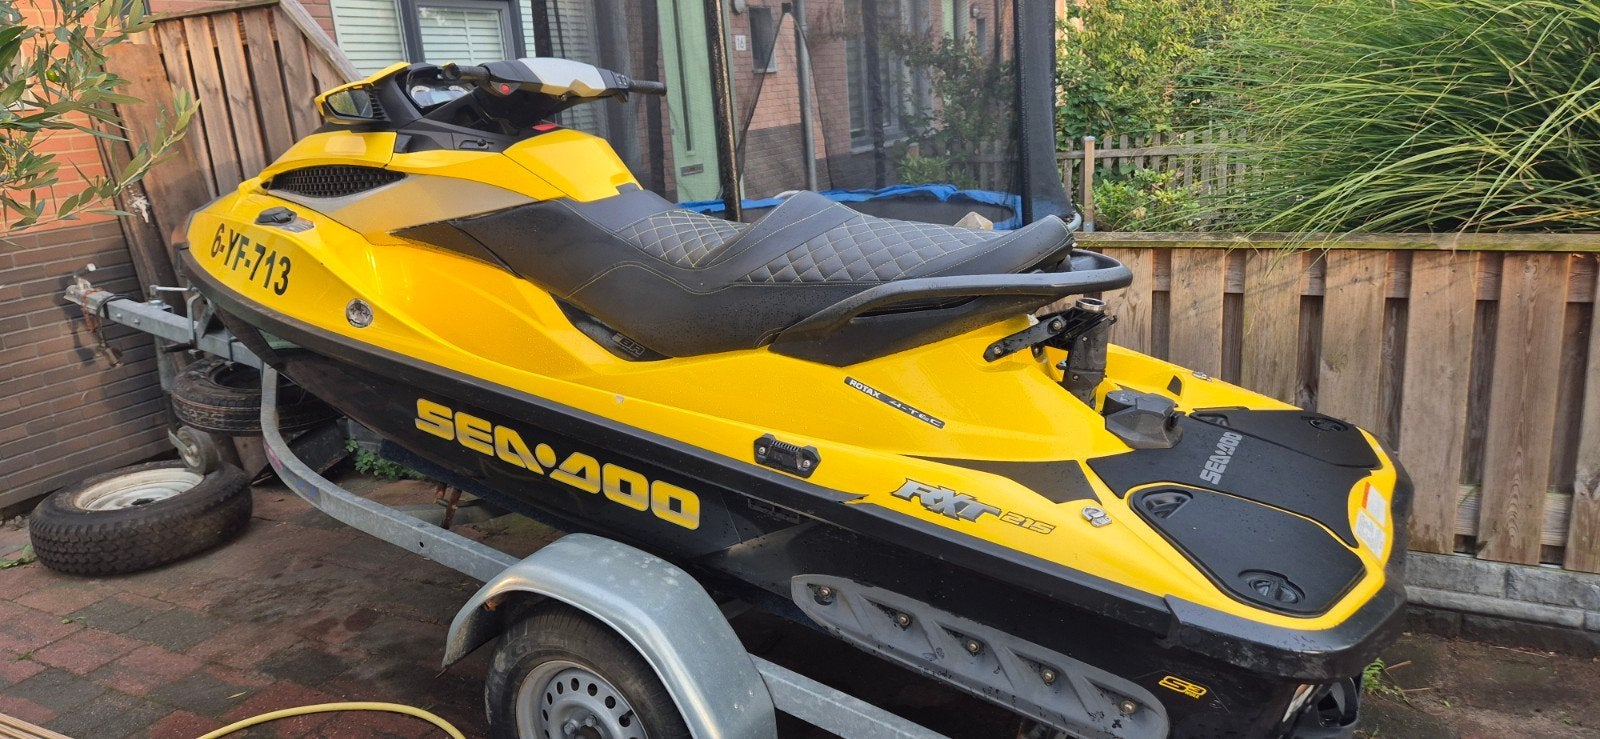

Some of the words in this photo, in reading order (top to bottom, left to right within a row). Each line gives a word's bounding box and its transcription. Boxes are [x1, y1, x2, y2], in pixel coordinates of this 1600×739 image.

[210, 222, 292, 296] 6-YF-713
[849, 379, 881, 399] ROTAX
[889, 477, 1002, 523] RXT
[999, 511, 1056, 535] 215
